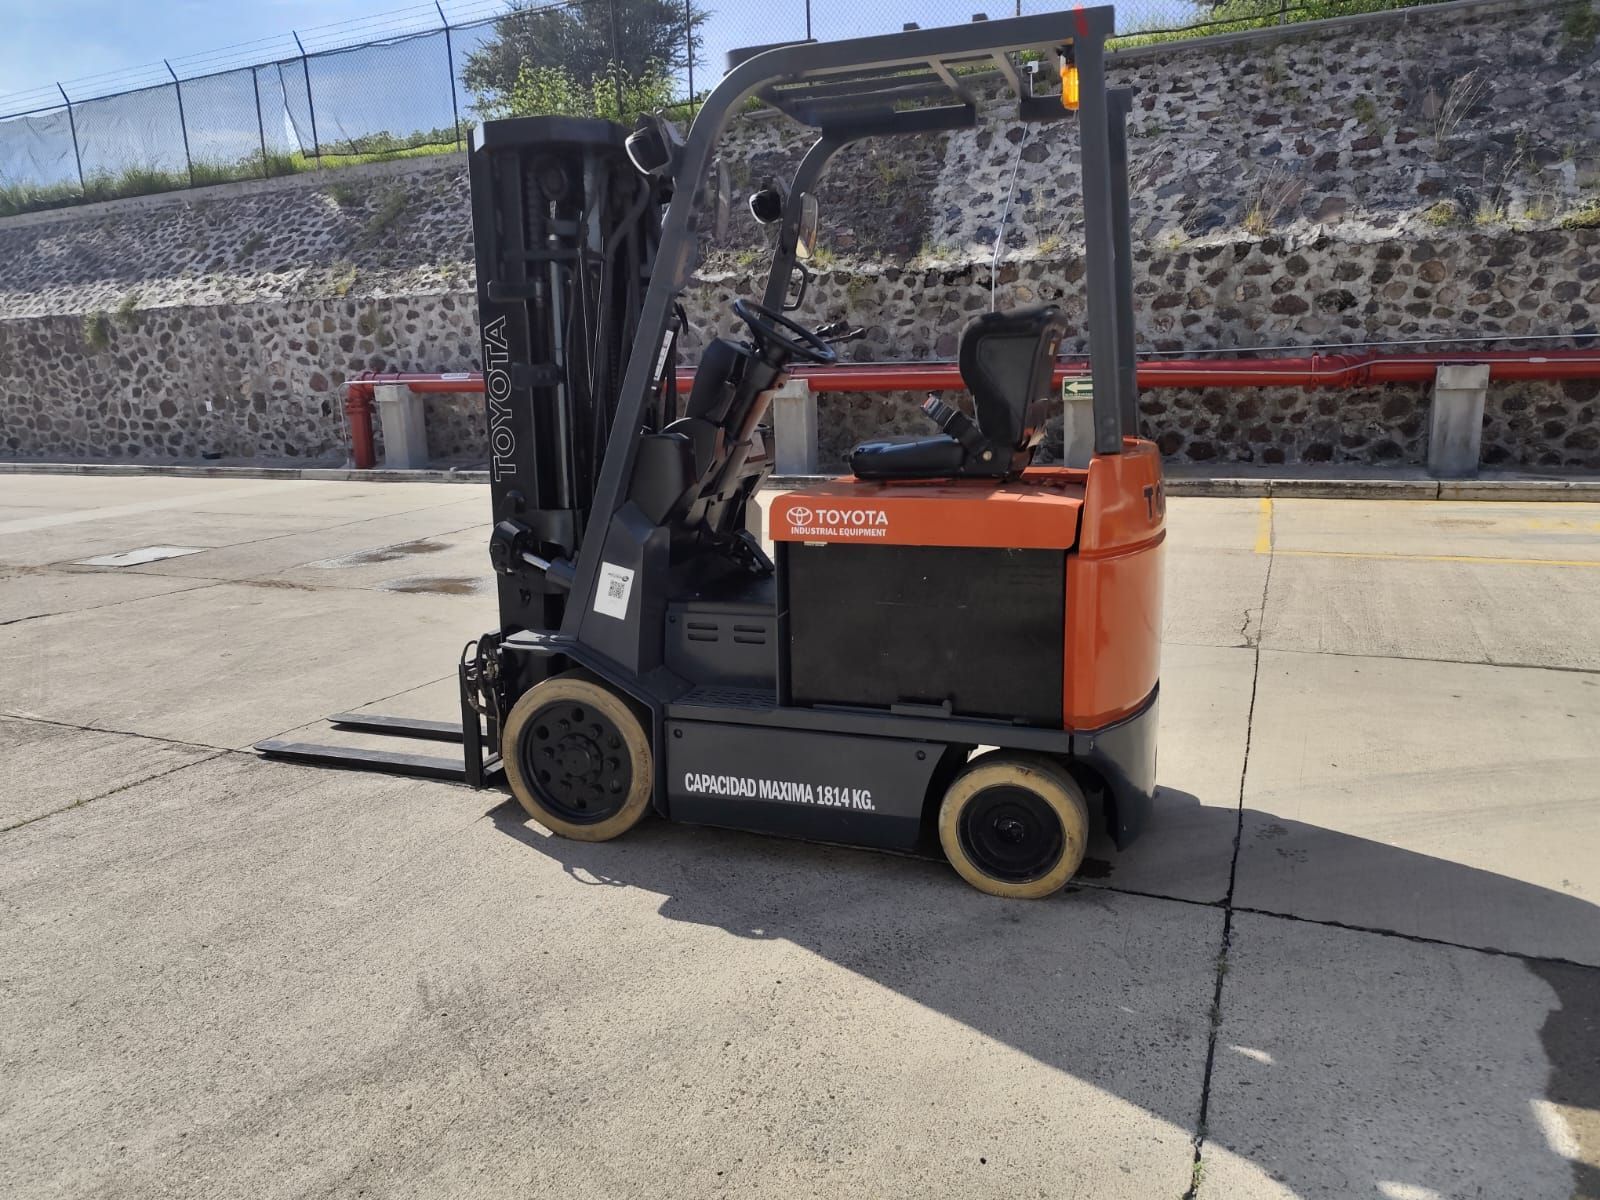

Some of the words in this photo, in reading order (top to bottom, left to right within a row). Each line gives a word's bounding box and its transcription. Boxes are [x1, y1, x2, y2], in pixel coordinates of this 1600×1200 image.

[484, 315, 516, 482] TOYOTA
[816, 510, 888, 525] TOYOTA
[791, 527, 837, 535] INDUSTRIAL
[840, 528, 886, 536] EQUIPMENT
[685, 773, 756, 797] CAPACIDAD
[759, 780, 814, 803] MAXIMA
[816, 785, 850, 808] 1814
[852, 788, 876, 811] KG.
